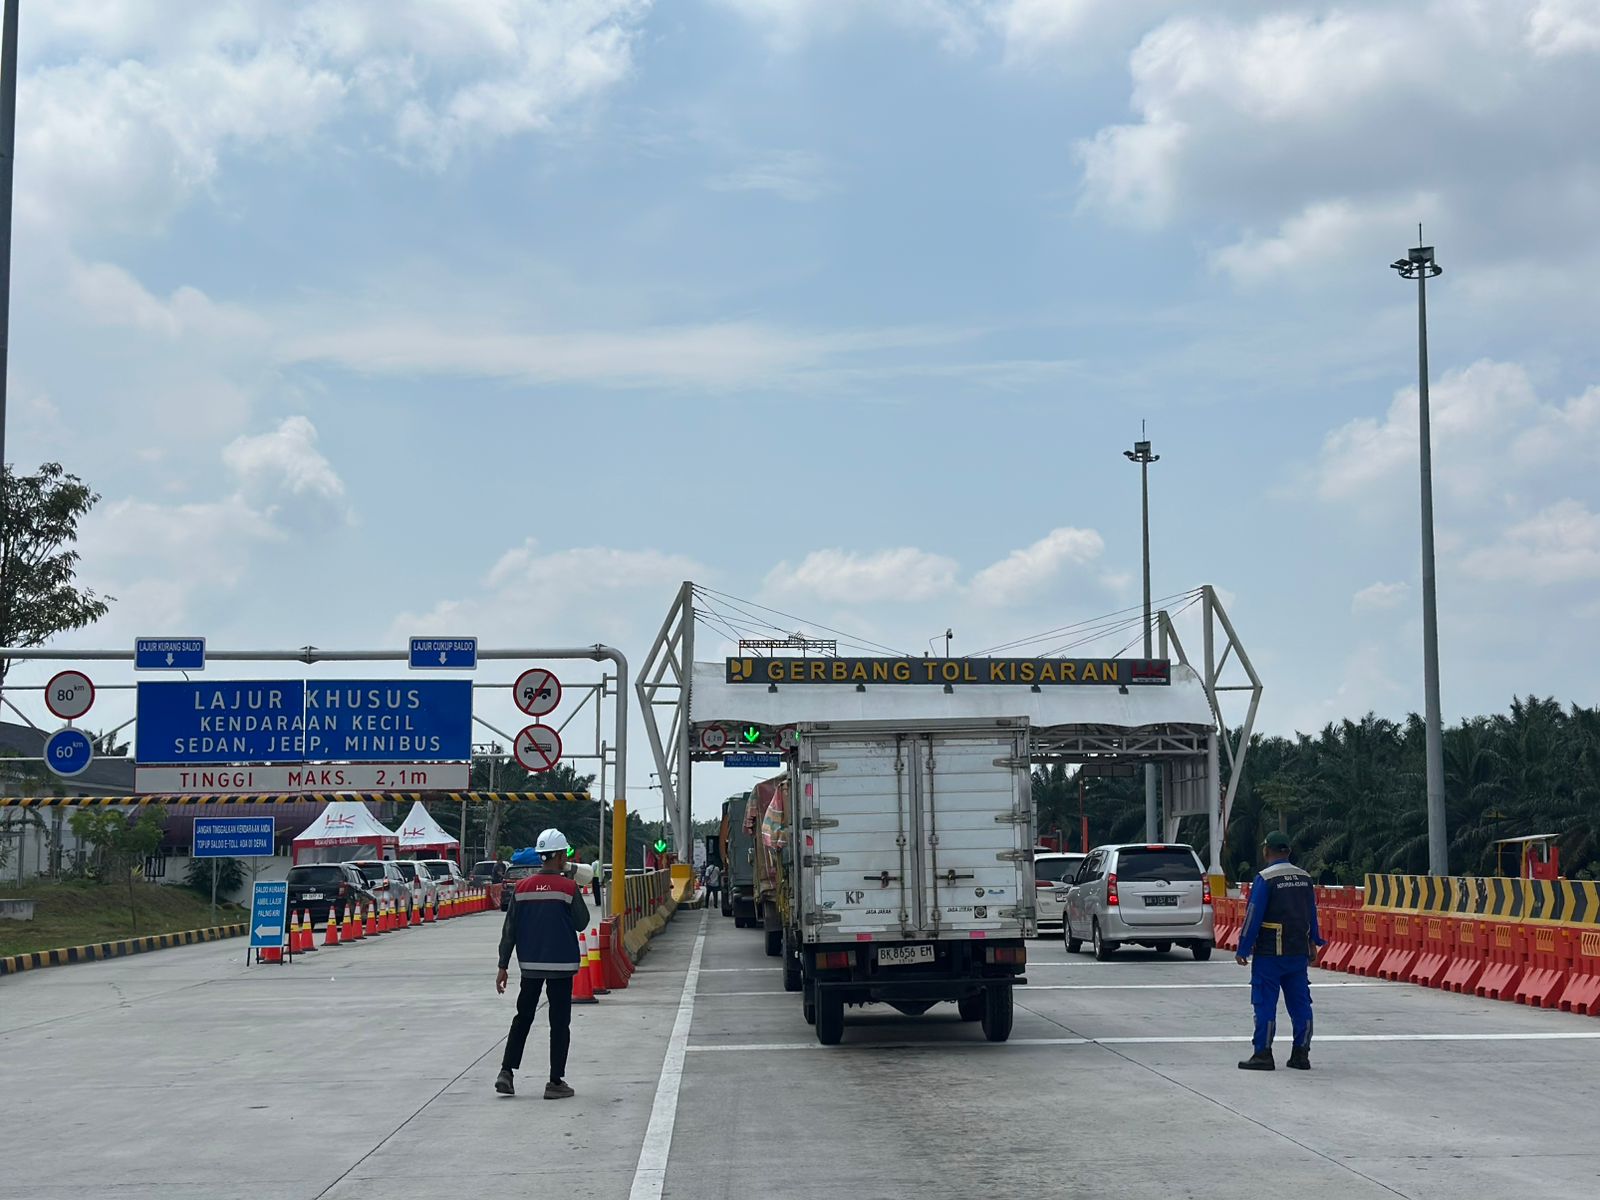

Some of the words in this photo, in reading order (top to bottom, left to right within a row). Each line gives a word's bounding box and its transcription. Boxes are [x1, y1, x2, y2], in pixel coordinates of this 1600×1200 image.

[139, 641, 157, 651] LAJUR
[158, 641, 181, 651] KURANG
[182, 641, 200, 651] SALDO
[413, 640, 432, 651] LAJUR
[433, 640, 452, 651] CUKUP
[453, 640, 473, 651] SALDO
[767, 660, 911, 681] GERBANG
[923, 660, 978, 681] TOL
[990, 661, 1118, 682] KISARAN
[57, 689, 74, 702] 80
[74, 684, 85, 692] km
[195, 689, 282, 710] LAJUR
[306, 689, 420, 709] KHUSUS
[200, 715, 337, 732] KENDARAAN
[352, 714, 414, 731] KECIL
[56, 745, 73, 759] 60
[73, 740, 84, 748] km
[174, 737, 254, 755] SEDAN,
[267, 736, 329, 754] JEEP,
[345, 735, 441, 752] MINIBUS
[180, 772, 253, 788] TINGGI
[288, 770, 352, 787] MAKS.
[376, 769, 427, 787] 2,1m
[845, 890, 865, 905] KP
[880, 949, 892, 960] BK
[893, 947, 916, 959] 8656
[920, 946, 933, 957] EM
